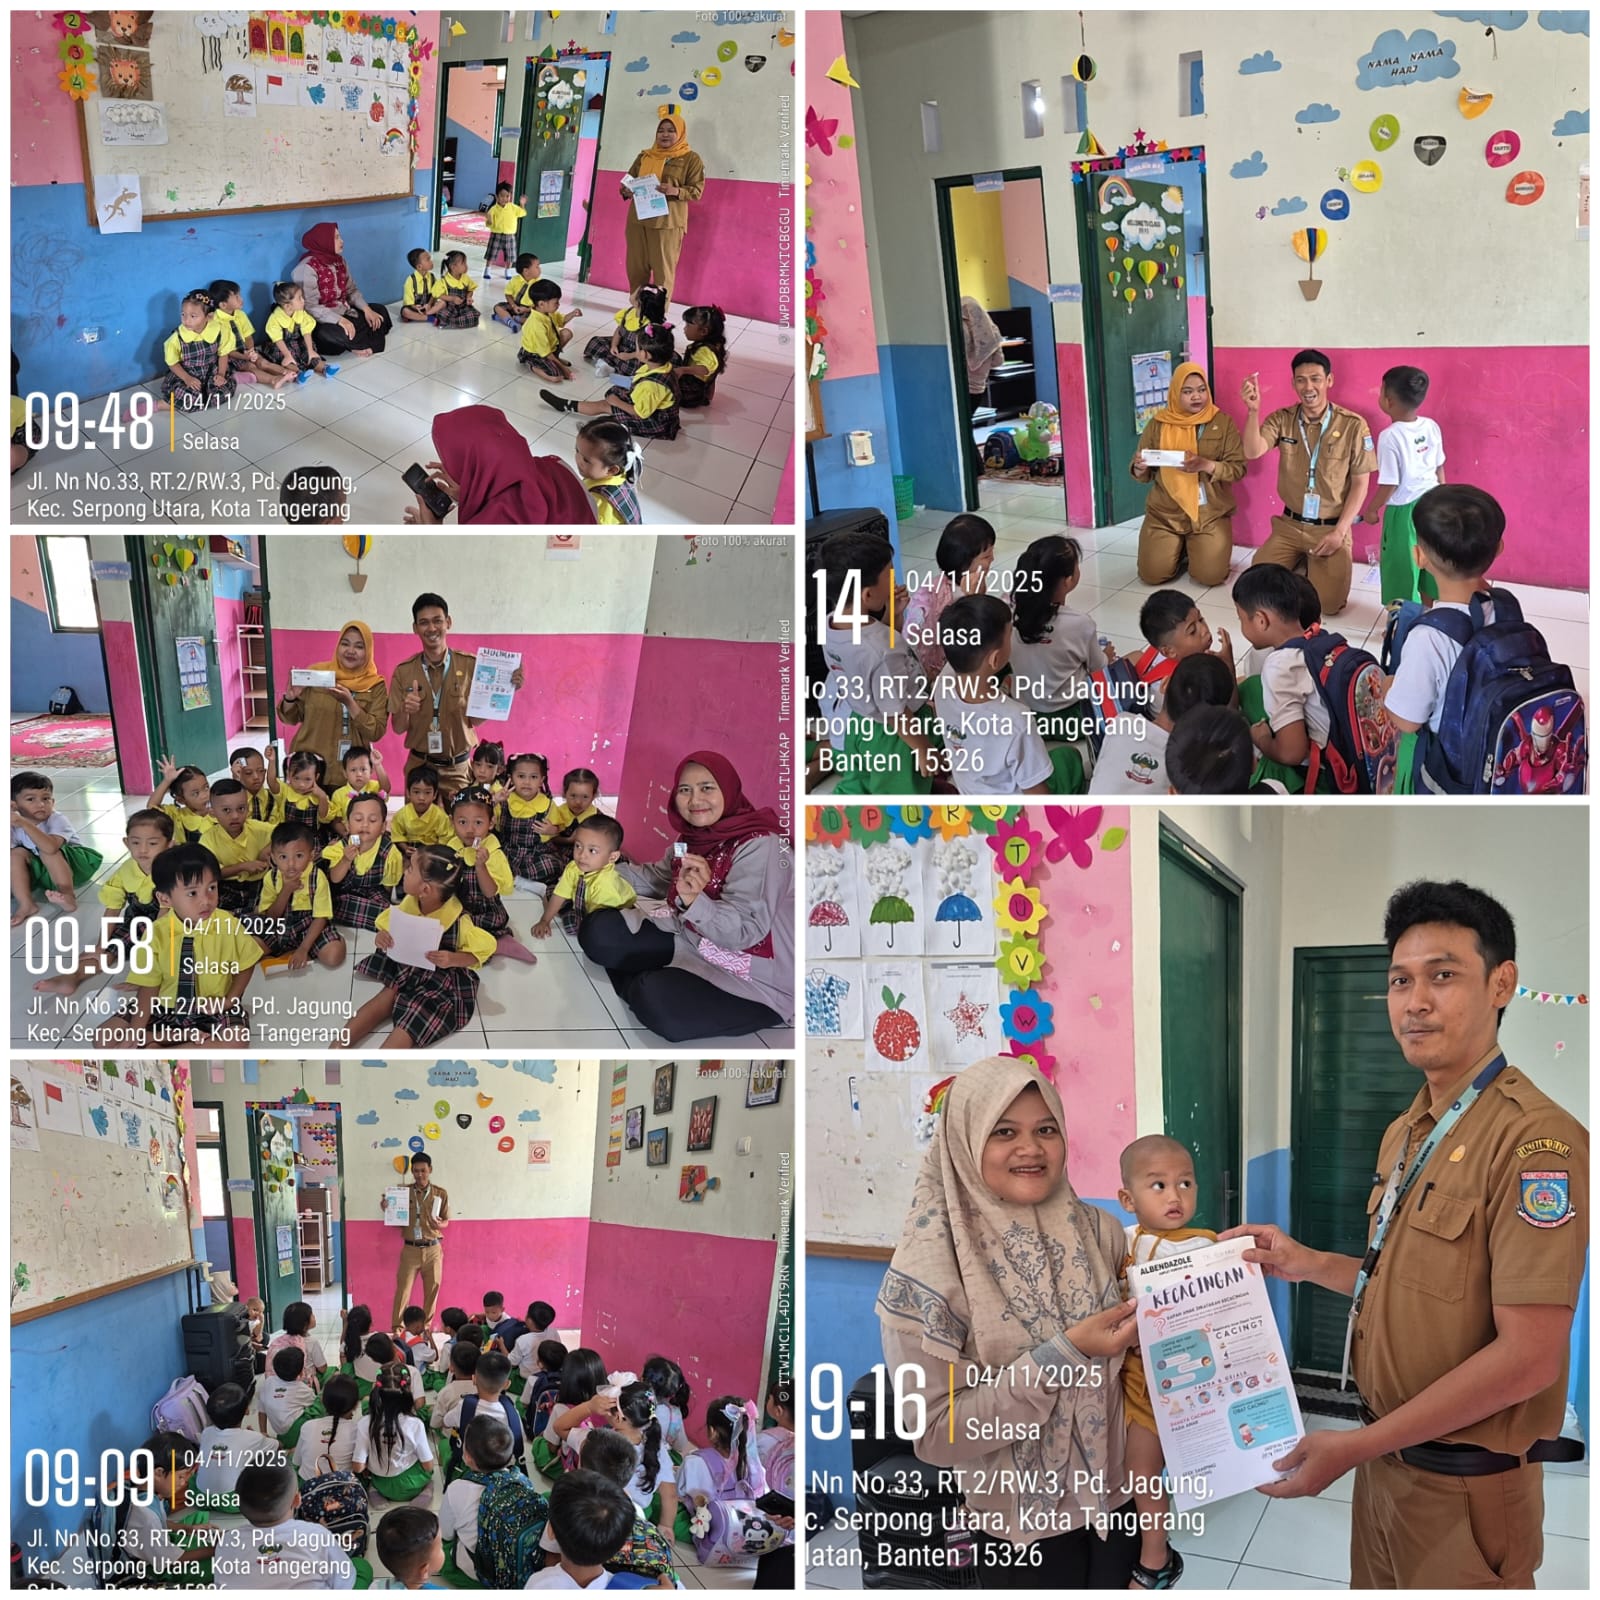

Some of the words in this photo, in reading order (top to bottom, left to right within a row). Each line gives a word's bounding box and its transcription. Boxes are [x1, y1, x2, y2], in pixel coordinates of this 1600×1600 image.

[68, 14, 77, 27] 2
[71, 45, 80, 60] 3
[1367, 57, 1400, 69] NAMA
[1410, 48, 1444, 61] NAMA
[73, 76, 82, 89] 4
[866, 808, 878, 827] P
[1012, 844, 1024, 862] T
[1014, 901, 1026, 916] U
[1015, 954, 1029, 971] V
[1017, 1014, 1036, 1027] W
[1140, 1256, 1192, 1276] ALBENDAZOLE
[1152, 1266, 1244, 1309] KECACINGAN
[1216, 1320, 1263, 1340] CACING?
